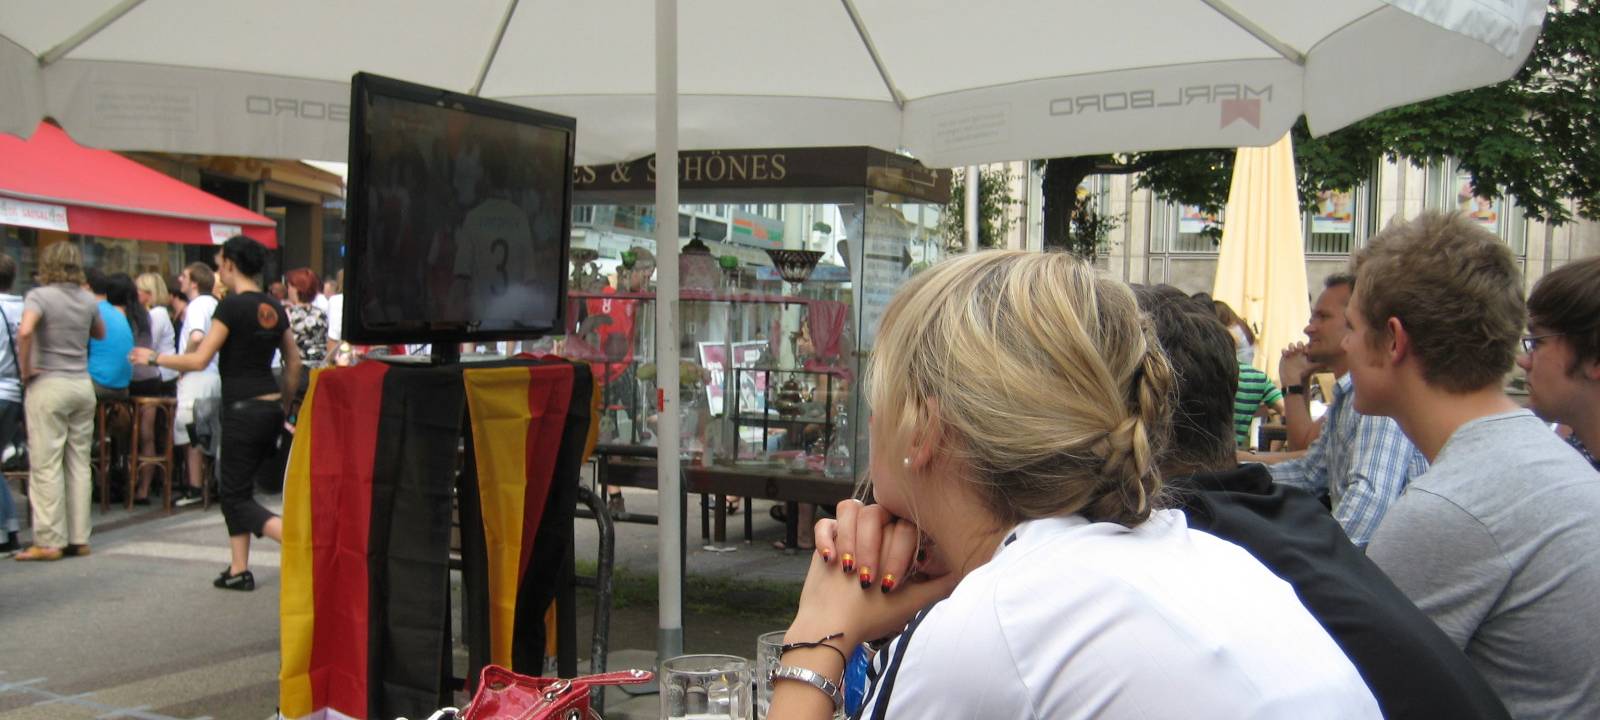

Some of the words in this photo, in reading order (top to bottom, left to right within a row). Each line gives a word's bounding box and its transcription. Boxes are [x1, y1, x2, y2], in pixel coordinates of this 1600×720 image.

[611, 161, 631, 182] &
[647, 151, 786, 182] SHÖNES
[490, 238, 509, 298] 3
